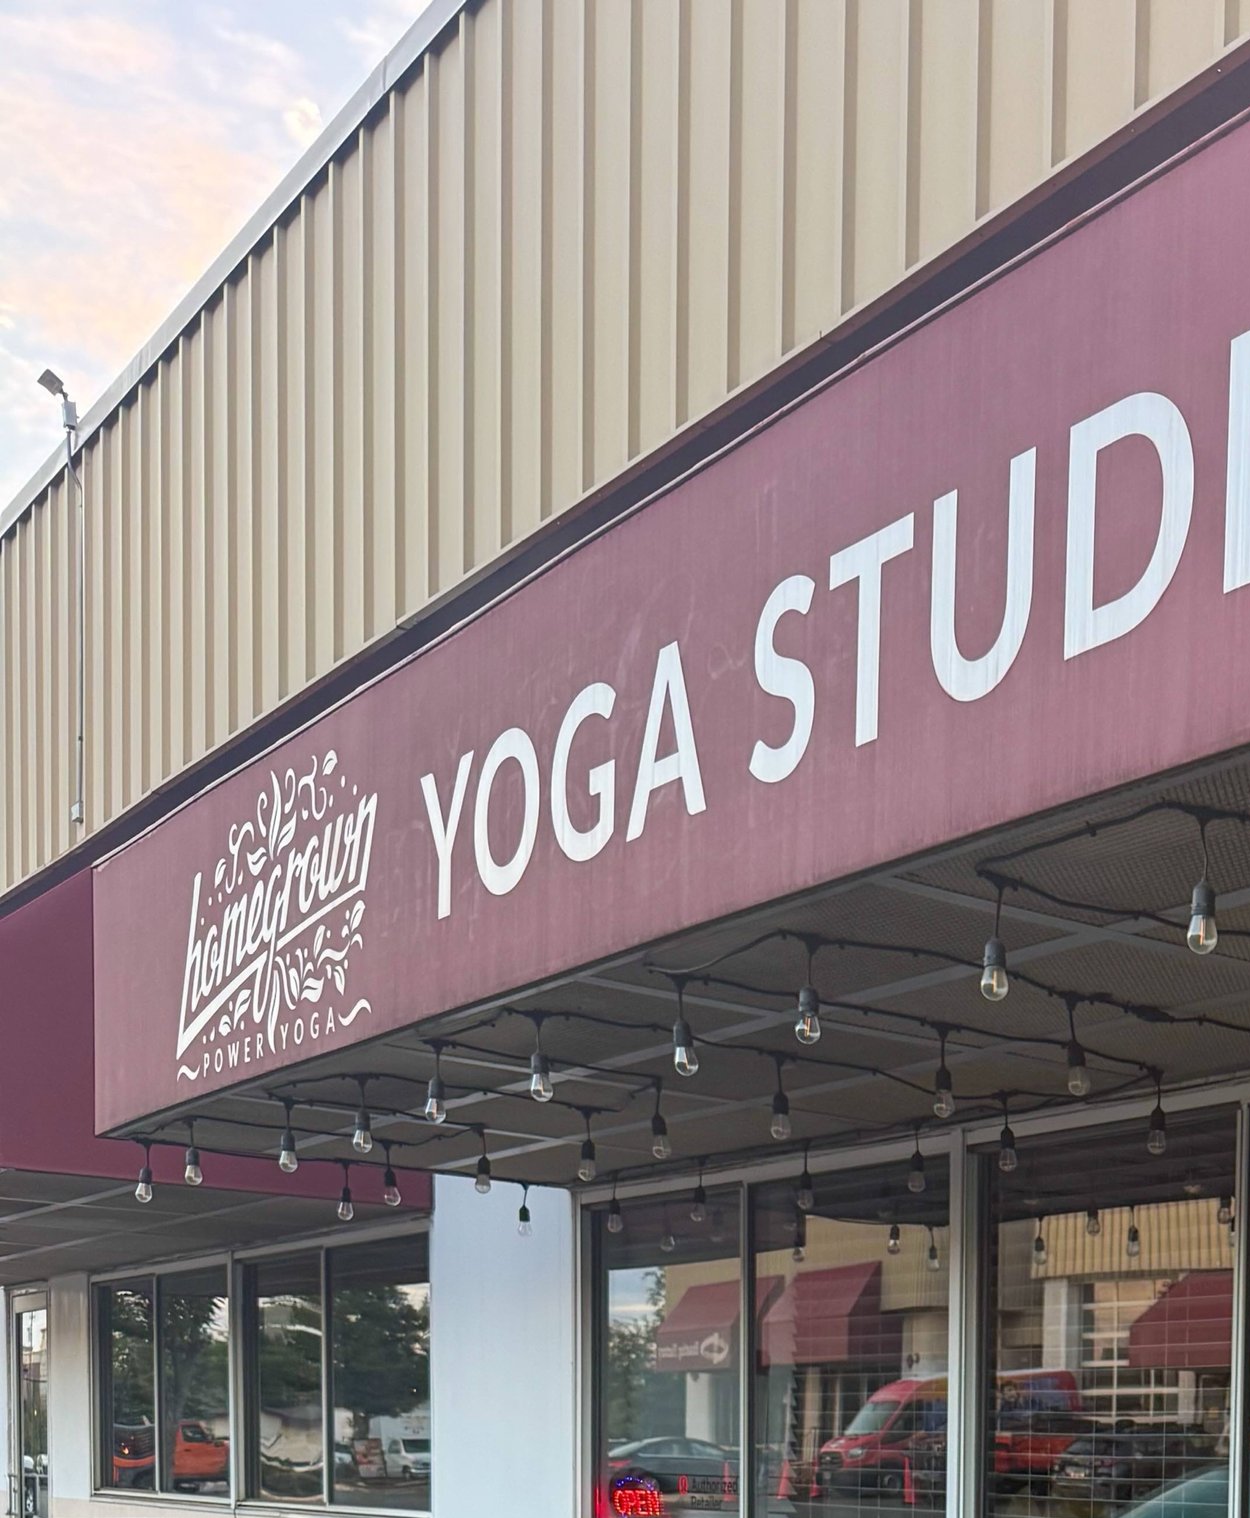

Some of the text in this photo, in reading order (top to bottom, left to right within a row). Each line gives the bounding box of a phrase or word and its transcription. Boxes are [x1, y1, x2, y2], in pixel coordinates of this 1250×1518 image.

[420, 641, 708, 919] YOGA
[175, 792, 378, 1061] homegrown
[203, 1006, 337, 1079] POWER YOGA
[613, 1490, 661, 1516] OPEN
[692, 1477, 739, 1494] Authorized
